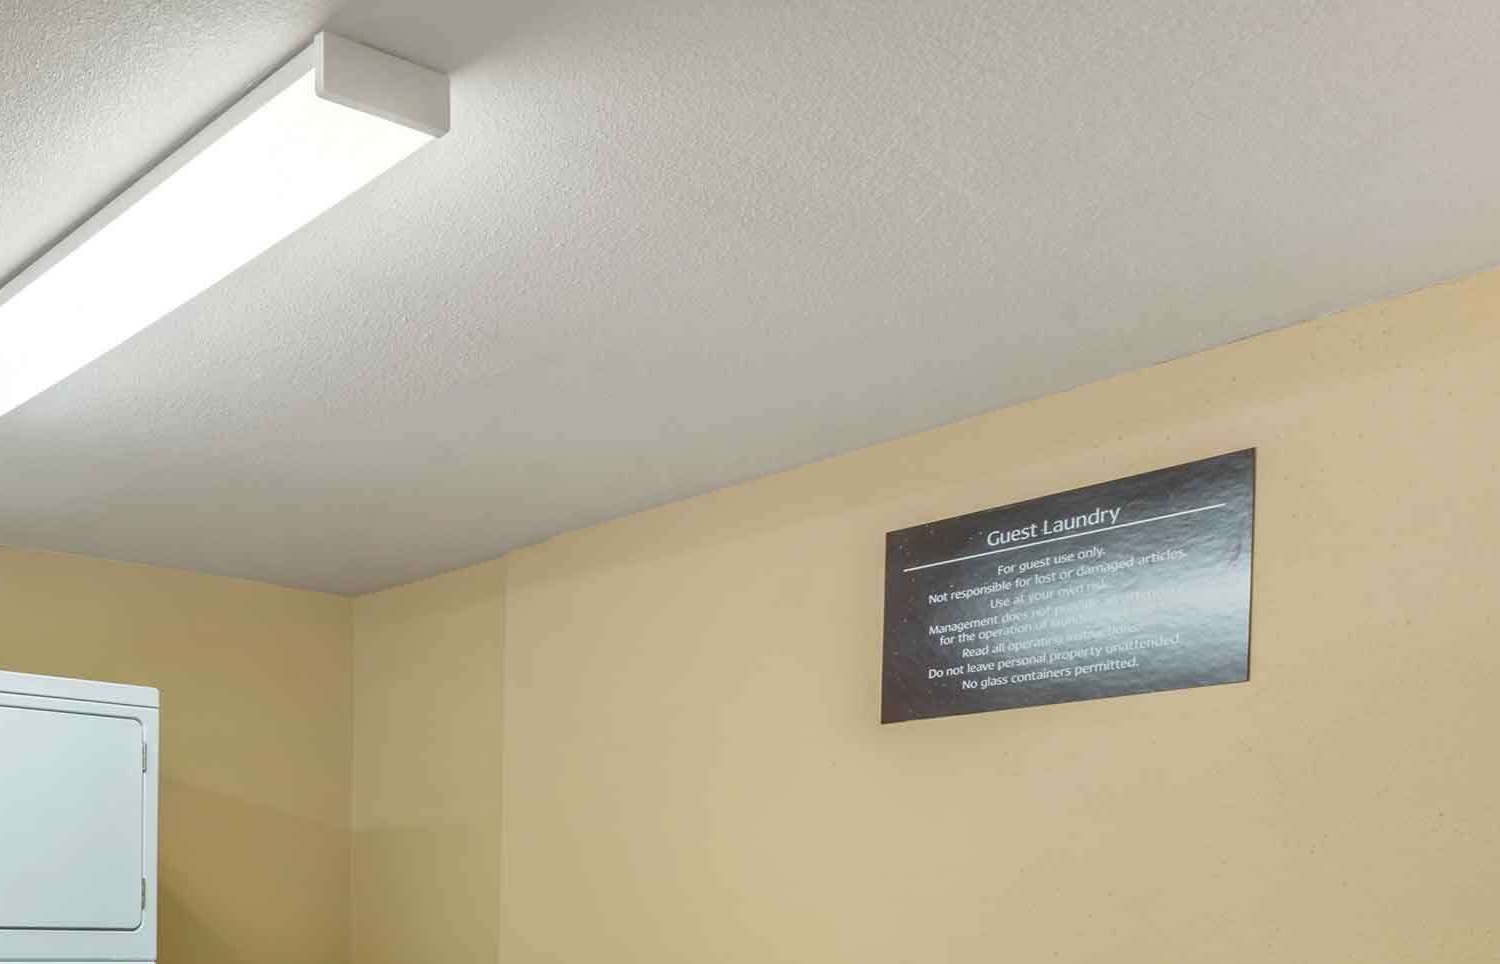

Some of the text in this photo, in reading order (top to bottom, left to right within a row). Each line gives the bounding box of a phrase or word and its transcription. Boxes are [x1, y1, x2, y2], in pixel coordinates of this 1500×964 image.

[987, 507, 1120, 546] Guest Laundry
[997, 546, 1106, 575] For guest use only.
[928, 593, 948, 605] Not
[950, 581, 1012, 600] responsible
[1015, 576, 1031, 589] for
[1035, 572, 1056, 584] lost
[1060, 569, 1075, 580] or
[1076, 557, 1134, 577] damaged
[990, 598, 1011, 609] Use
[1013, 595, 1024, 605] at
[1028, 589, 1053, 604] your
[928, 615, 998, 635] Management
[1001, 611, 1029, 623] does
[939, 635, 955, 646] for
[958, 632, 975, 643] the
[978, 623, 1032, 640] operation
[962, 645, 989, 658] Read
[991, 643, 1005, 654] all
[1007, 636, 1062, 653] operating
[928, 668, 944, 679] Do
[946, 665, 964, 676] not
[967, 660, 995, 673] leave
[997, 653, 1046, 671] personal
[1049, 646, 1102, 664] property
[962, 656, 1140, 690] No glass containers permitted.
